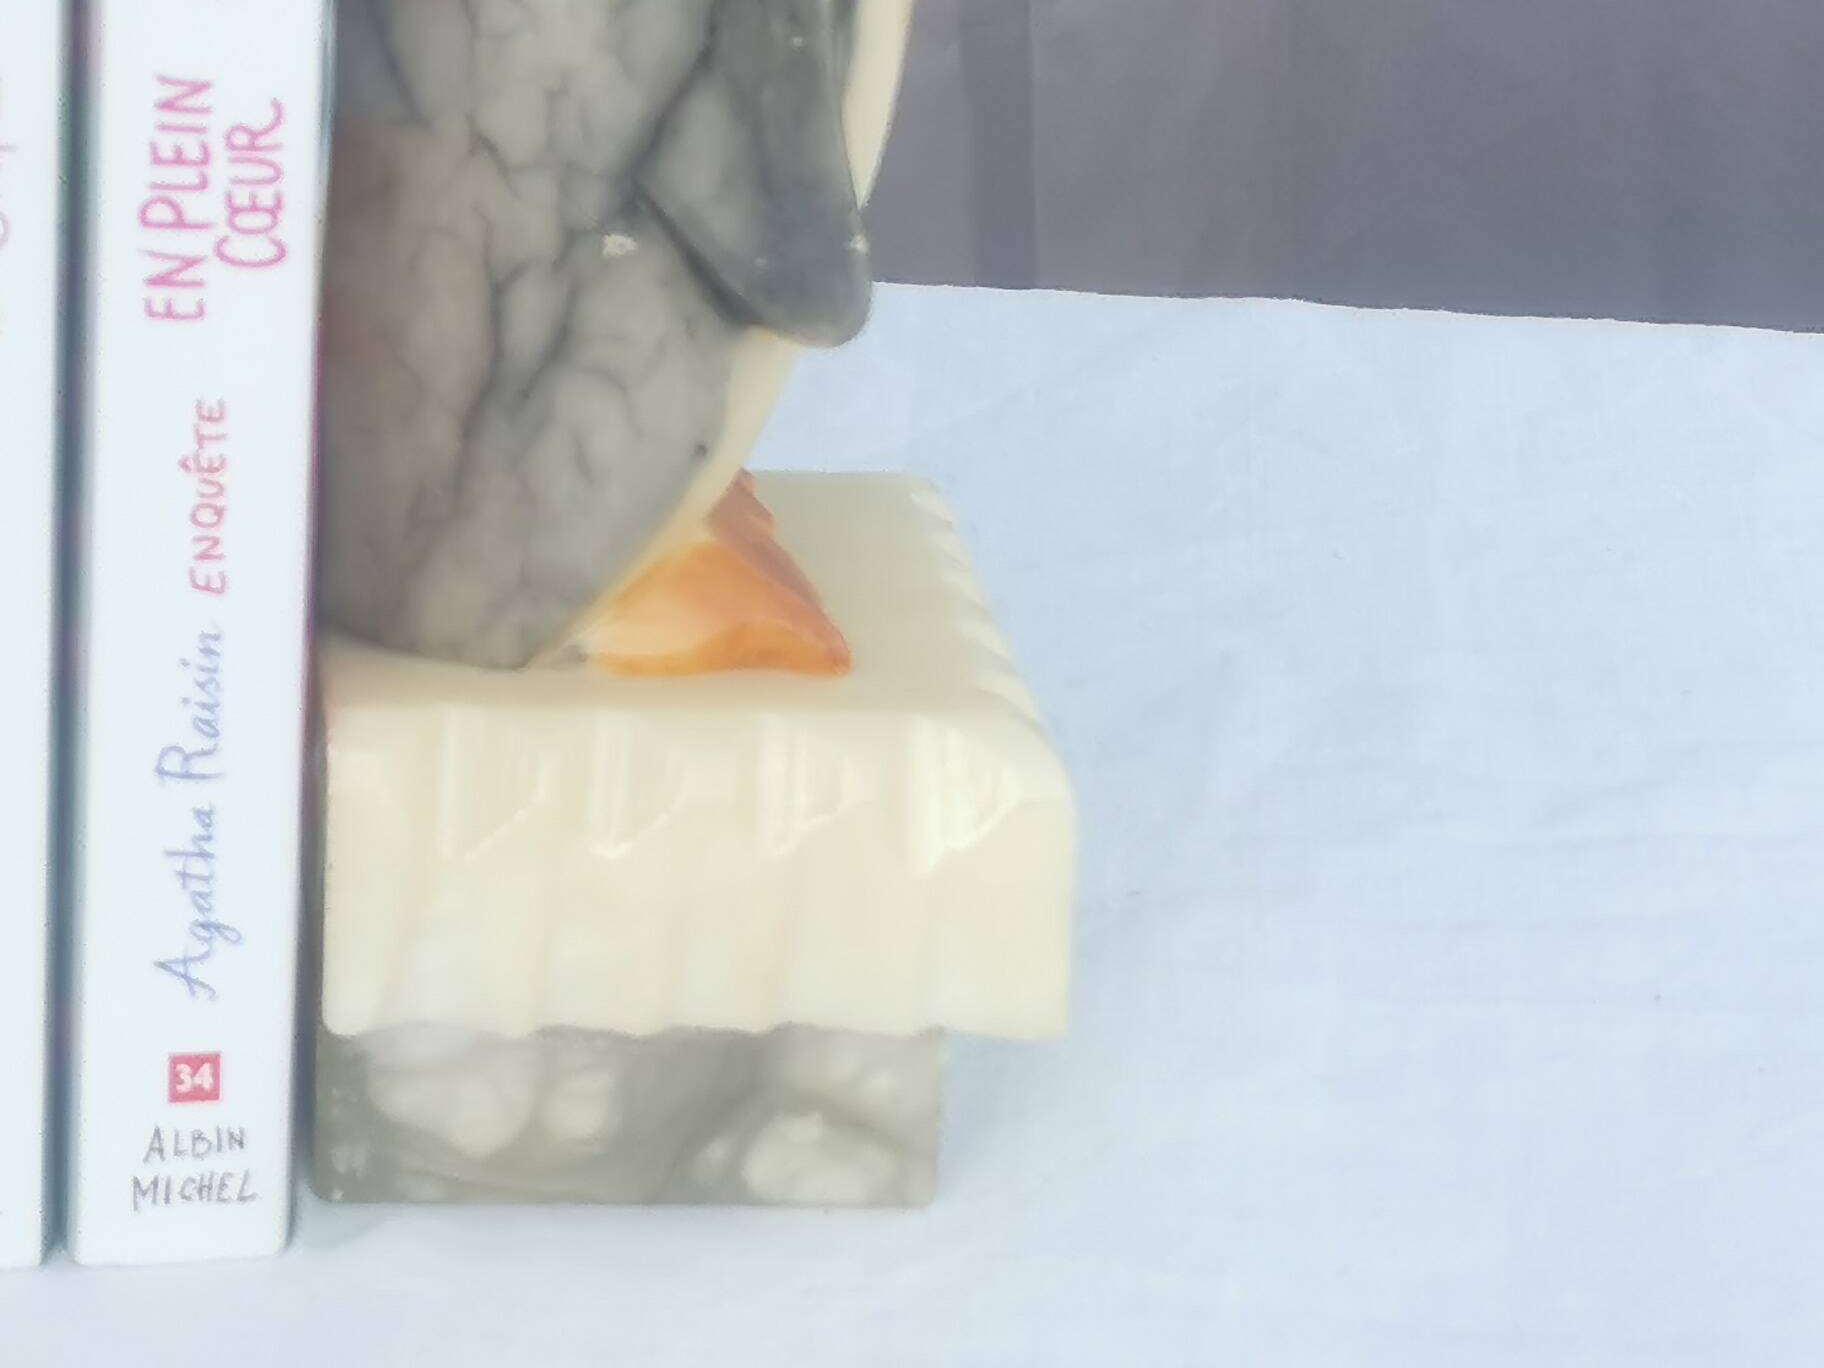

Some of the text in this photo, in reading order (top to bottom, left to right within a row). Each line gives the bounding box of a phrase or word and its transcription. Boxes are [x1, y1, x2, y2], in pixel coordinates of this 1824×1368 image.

[135, 73, 217, 323] EN PLEIN
[223, 96, 290, 272] CŒUR
[152, 398, 244, 1001] Agatha Raisin ENQUÊTE
[129, 1168, 259, 1213] MICHEL
[141, 1124, 248, 1166] ALBIN
